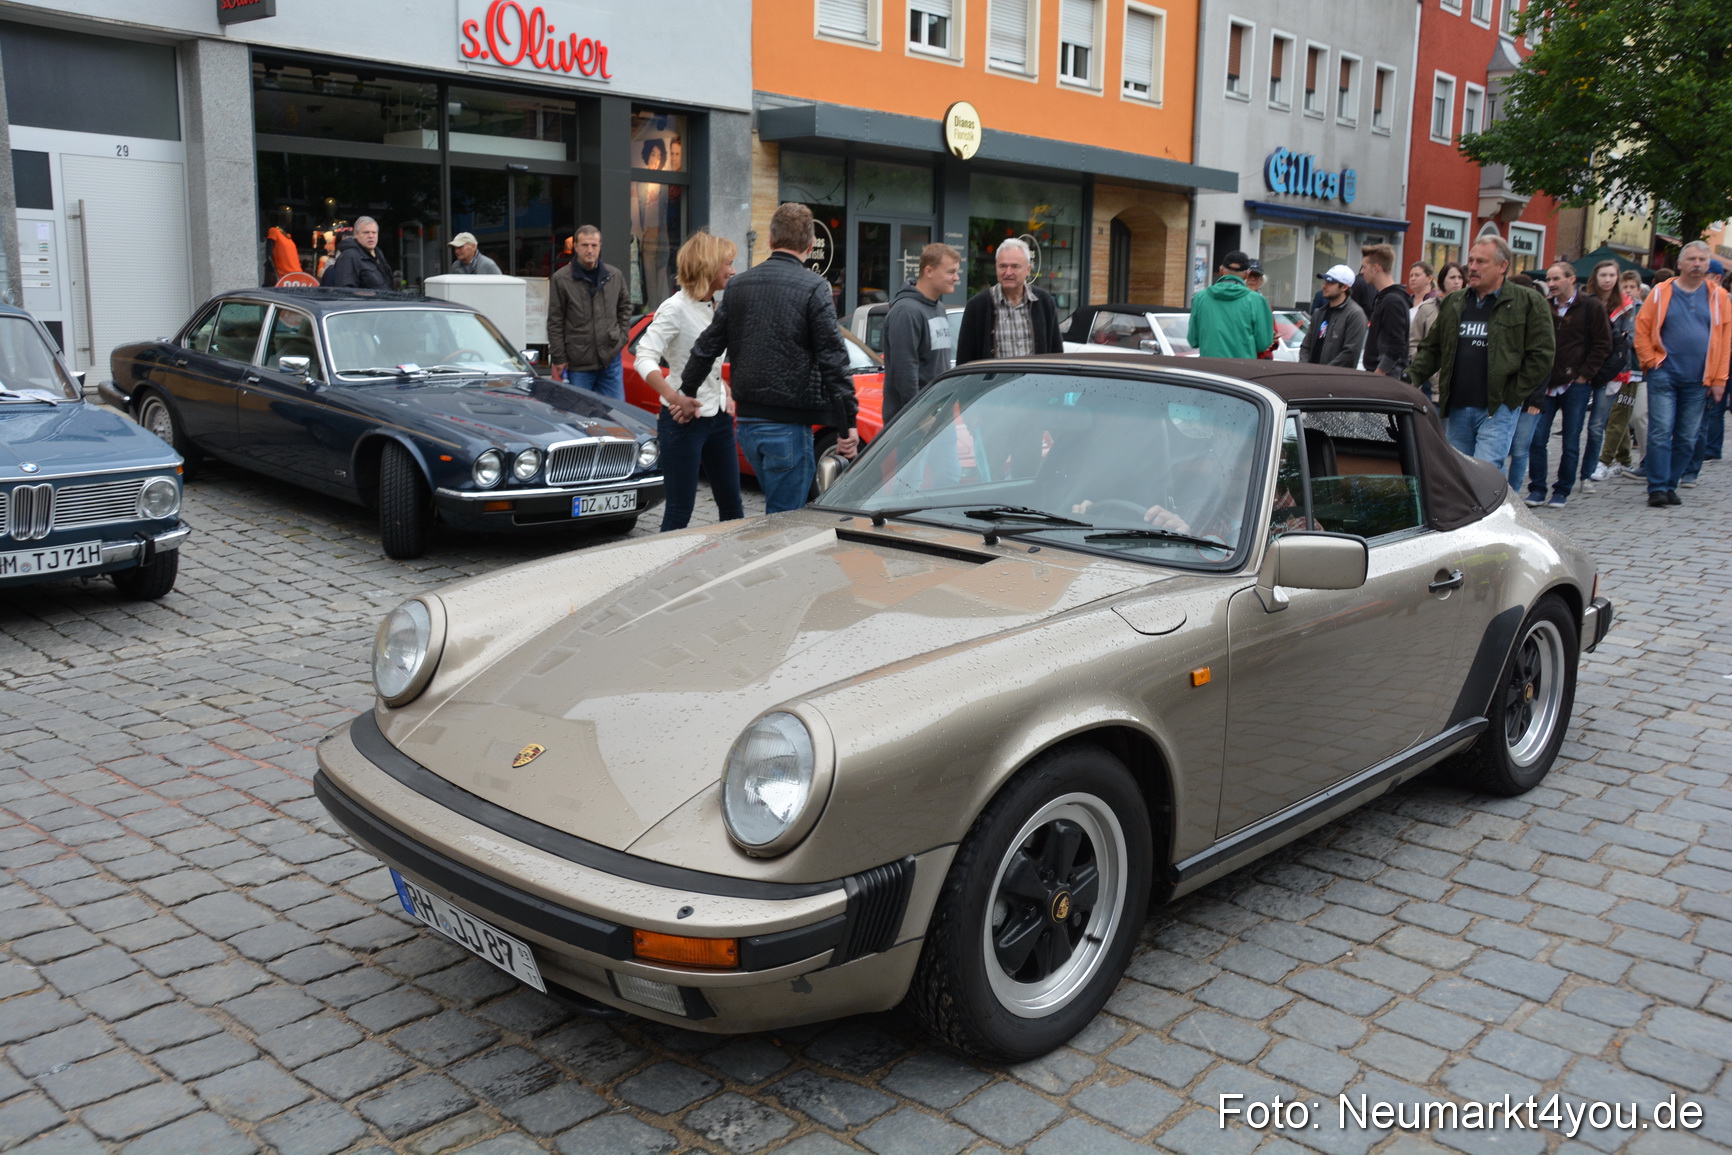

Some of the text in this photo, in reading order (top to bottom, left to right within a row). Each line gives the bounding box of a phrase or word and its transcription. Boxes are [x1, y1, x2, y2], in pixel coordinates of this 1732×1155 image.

[461, 0, 613, 79] s.Oliver
[954, 115, 975, 130] Dianas
[116, 144, 129, 157] 29
[1266, 146, 1339, 200] Eilles
[1471, 339, 1488, 347] POL
[580, 497, 597, 513] DZ
[0, 555, 18, 575] M
[402, 880, 441, 928] RH
[448, 907, 515, 973] JJ87
